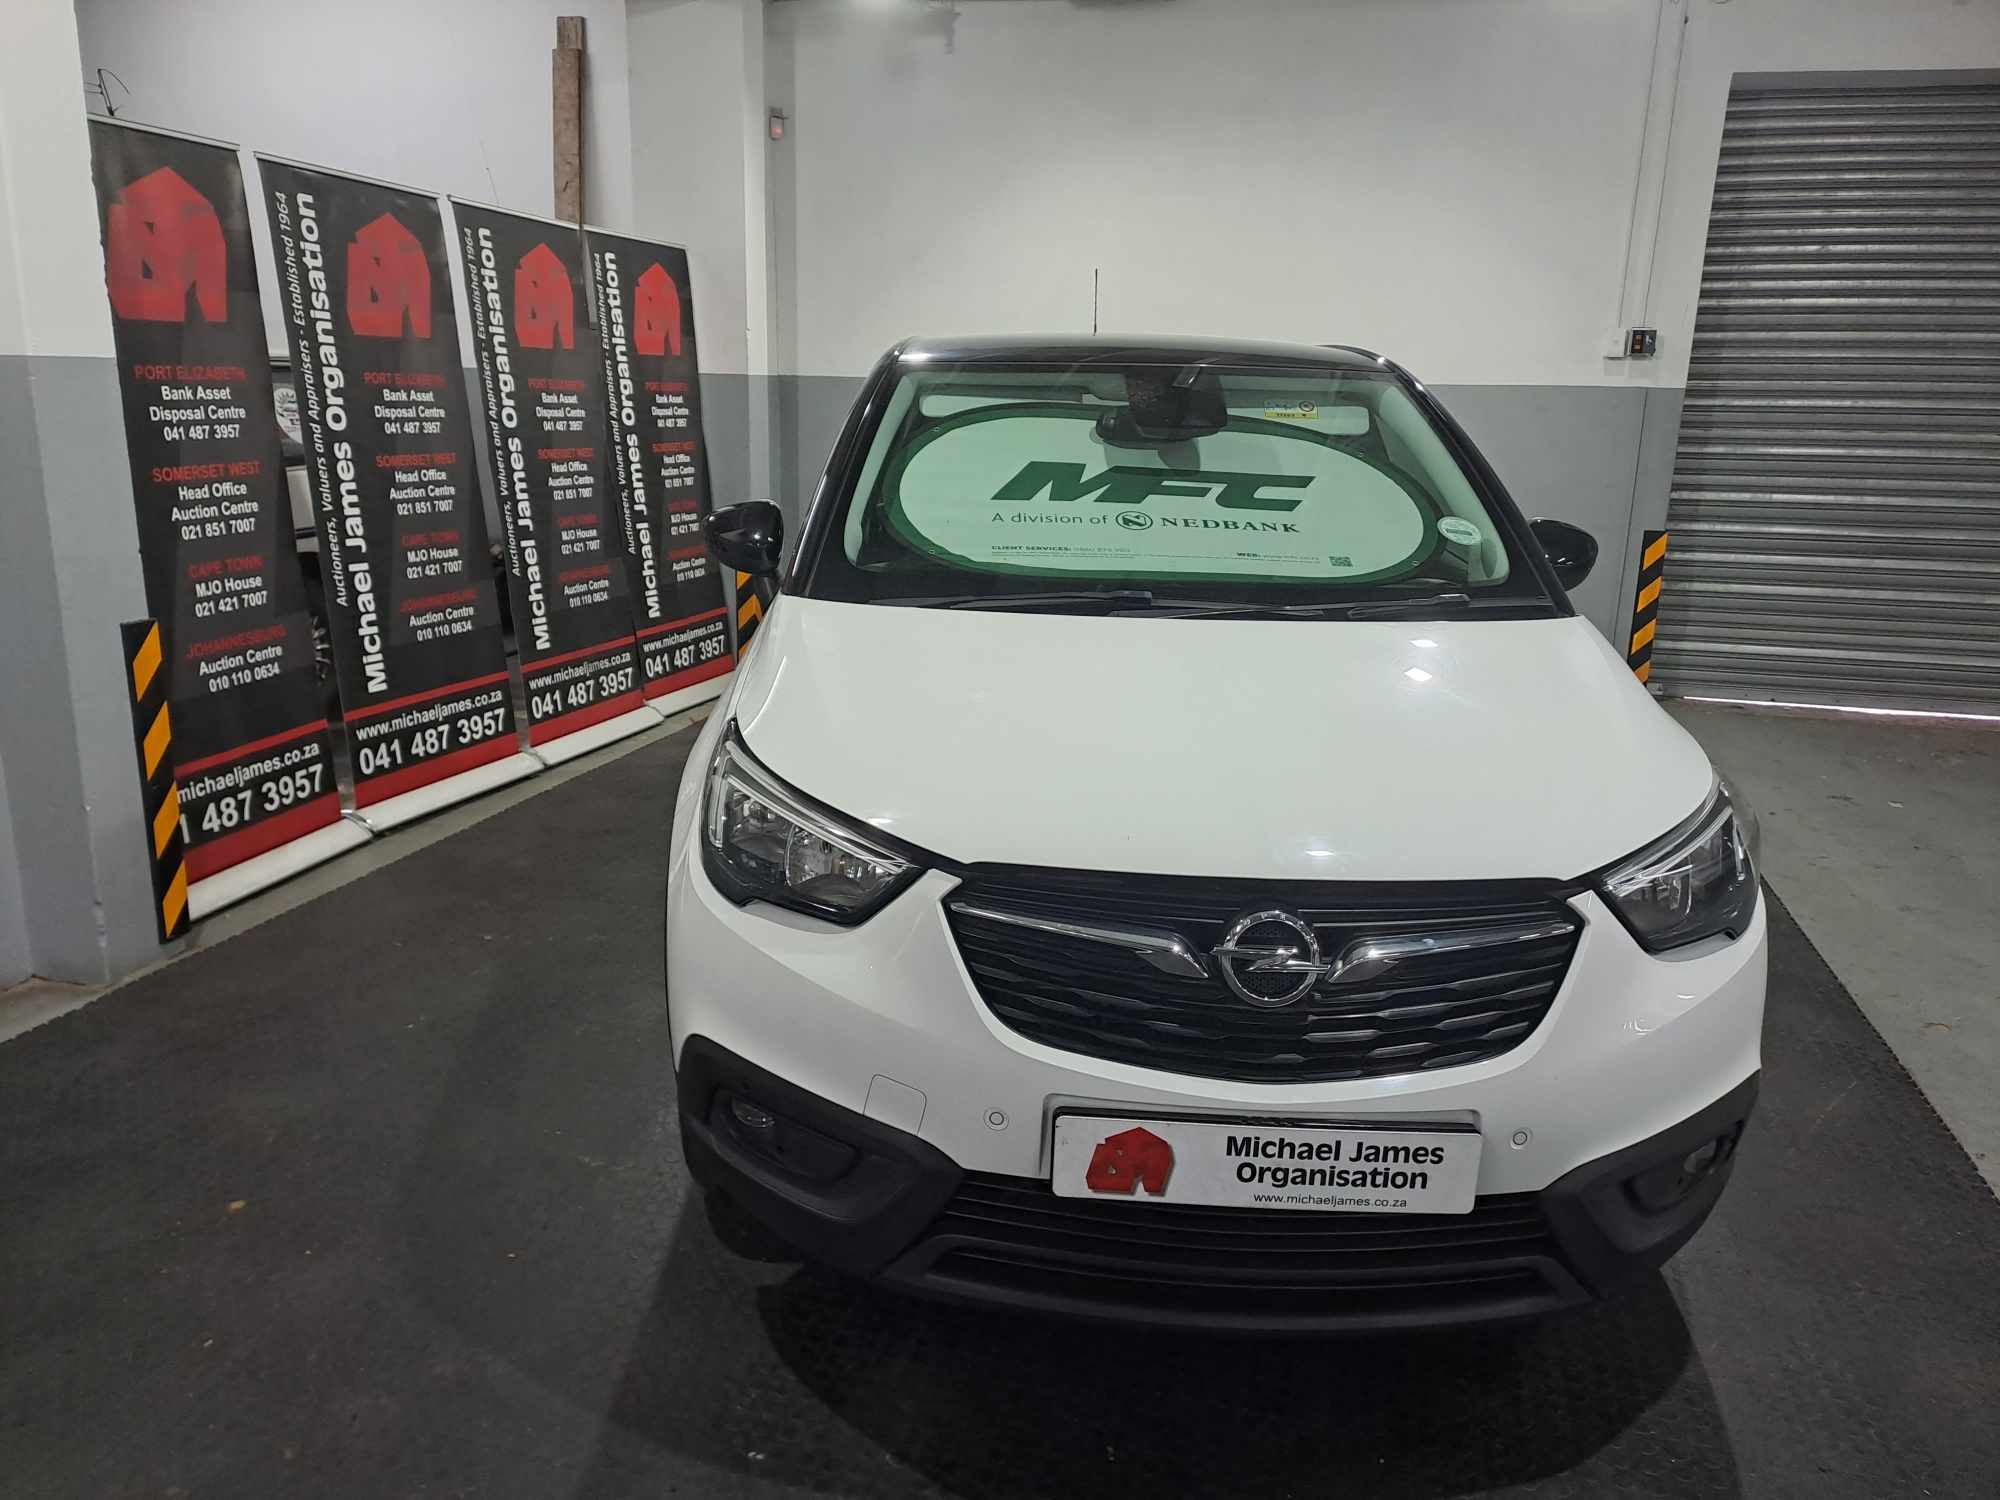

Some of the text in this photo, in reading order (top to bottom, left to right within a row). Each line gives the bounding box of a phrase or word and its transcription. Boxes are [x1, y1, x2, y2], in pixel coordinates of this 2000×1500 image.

[275, 191, 292, 233] 1964
[463, 227, 478, 262] 1964
[280, 235, 305, 326] Established
[465, 263, 487, 340] Established
[134, 365, 171, 380] PORT
[299, 339, 319, 421] Appraisers
[482, 350, 498, 420] Appraisers
[161, 386, 231, 400] Bank Asset
[383, 389, 434, 402] Bank Asset
[150, 405, 246, 423] Disposal Centre
[374, 405, 446, 419] Disposal Centre
[164, 424, 240, 441] 041 487 3957
[310, 423, 324, 453] and
[384, 422, 440, 434] 041 487 3957
[477, 227, 551, 650] Michael James Organisation
[489, 421, 501, 446] and
[604, 252, 661, 619] Michael James Organisation
[608, 420, 621, 443] and
[296, 192, 388, 694] Michael James Organisation
[152, 462, 260, 482] SOMERSET WEST
[395, 469, 446, 483] Head Office
[496, 449, 509, 496] Valuers
[614, 444, 626, 485] Valuers
[178, 482, 247, 500] Head Office
[318, 457, 335, 512] Valuers
[389, 485, 455, 500] Auction Centre
[548, 477, 572, 488] Auction
[990, 460, 1316, 512] MFC
[171, 501, 259, 521] Auction Centre
[396, 500, 453, 515] 021 851 7007
[181, 519, 256, 540] 021 851 7007
[991, 513, 1301, 533] A division of NEDBANK
[326, 518, 349, 607] Auctioneers,
[407, 547, 458, 563] MJO House
[406, 560, 463, 579] 021 421 7007
[195, 576, 262, 598] MJO House
[564, 582, 587, 595] Auction
[195, 591, 268, 617] 021 421 7007
[409, 606, 474, 627] Auction Centre
[416, 621, 472, 641] 010 110 0634
[199, 645, 283, 676] Auction Centre
[645, 635, 725, 679] 041 487 3957
[209, 662, 280, 692] 010 110 0634
[531, 667, 633, 719] 041 487 3957
[356, 689, 502, 741] www.michaeljames.co.za
[359, 708, 505, 775] 041 487 3957
[177, 743, 320, 803] michaeljames.co.za
[202, 790, 252, 832] 487
[261, 763, 323, 811] 3957
[1225, 1134, 1445, 1166] Michael James
[1236, 1161, 1429, 1190] Organisation
[1253, 1192, 1408, 1209] www.michaeljames.co.za
